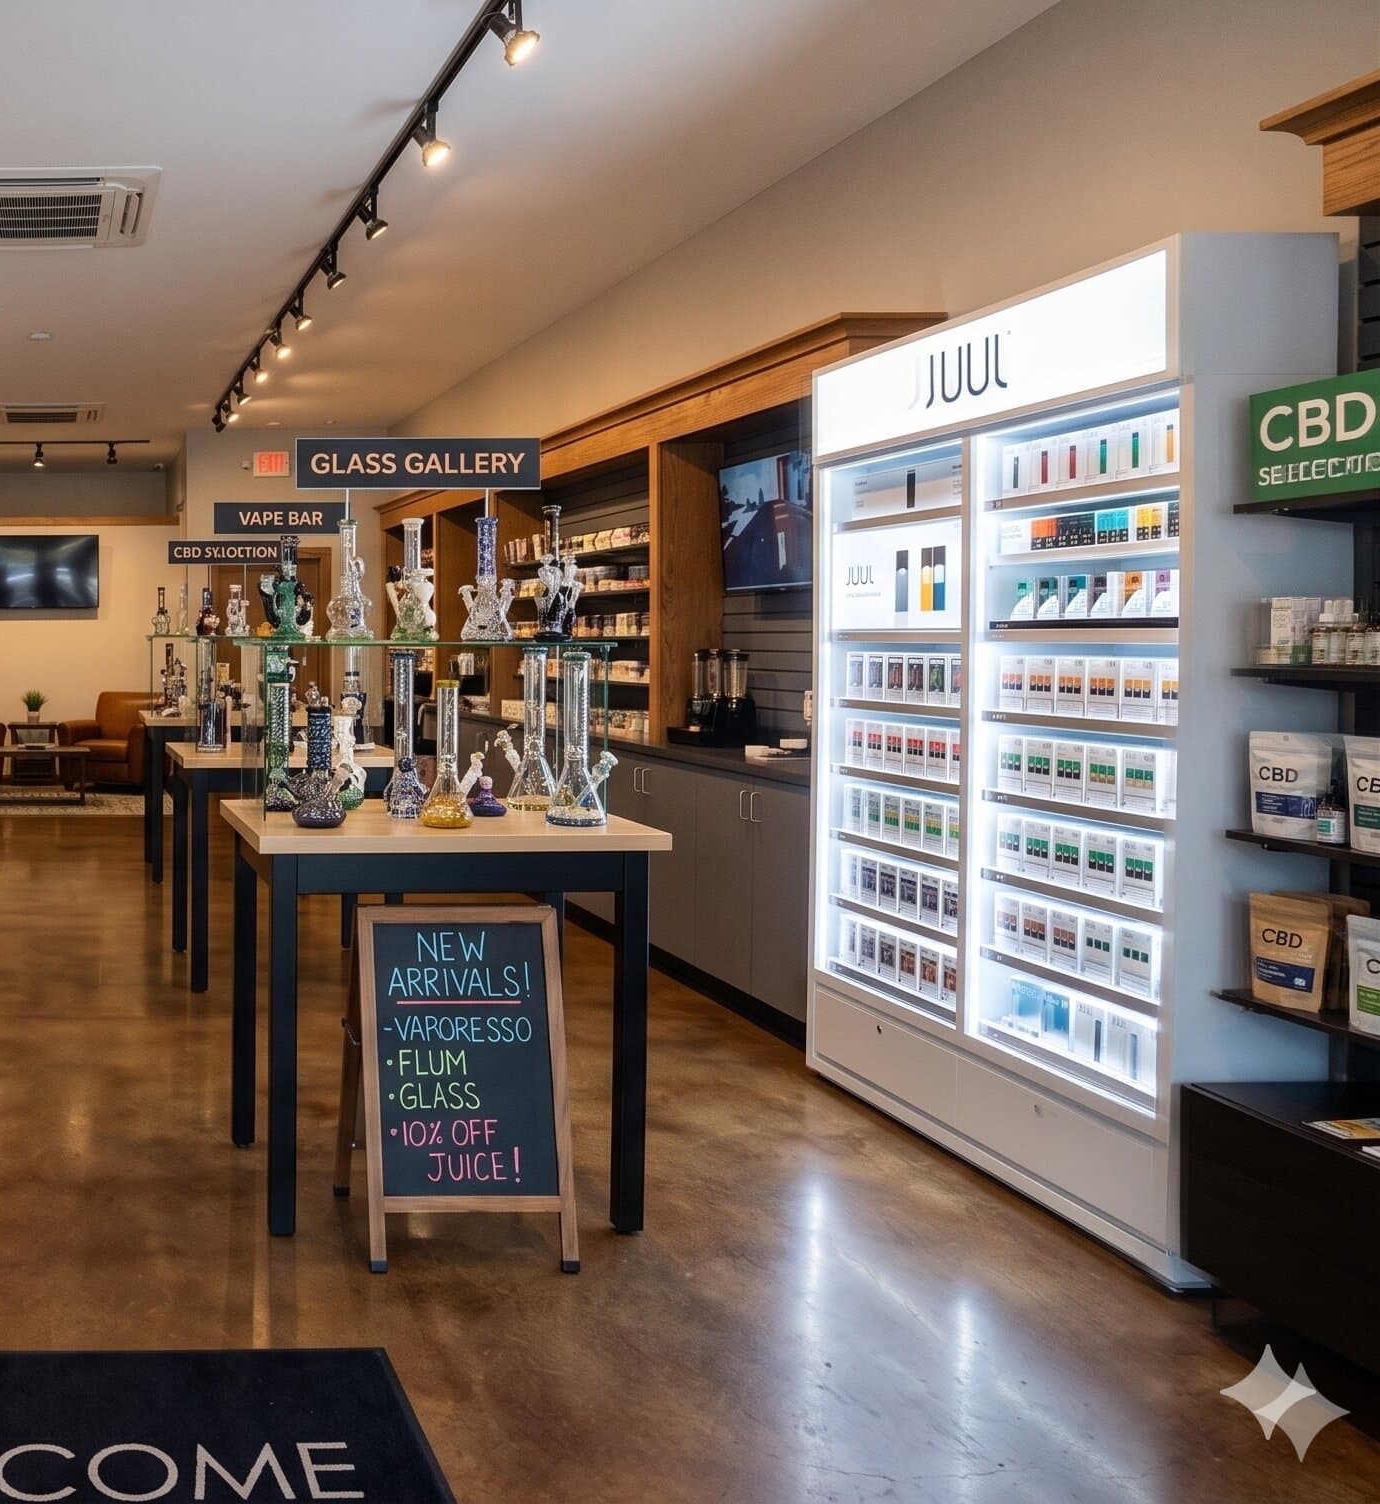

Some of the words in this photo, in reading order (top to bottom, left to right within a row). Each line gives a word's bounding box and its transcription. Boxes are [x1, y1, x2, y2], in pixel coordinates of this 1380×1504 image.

[925, 333, 1008, 409] JUUL
[1260, 391, 1377, 452] CBD
[310, 453, 397, 475] GLASS
[404, 453, 526, 475] GALLERY
[238, 511, 284, 526] VAPE
[288, 511, 324, 526] BAR
[173, 546, 202, 558] CBD
[845, 565, 874, 586] JUUL
[1258, 766, 1299, 783] CBD
[417, 931, 485, 962] NEW
[1262, 928, 1303, 948] CBD
[388, 961, 531, 998] ARRIVALS!
[451, 1119, 498, 1147] OFF
[427, 1146, 521, 1183] JUICE!
